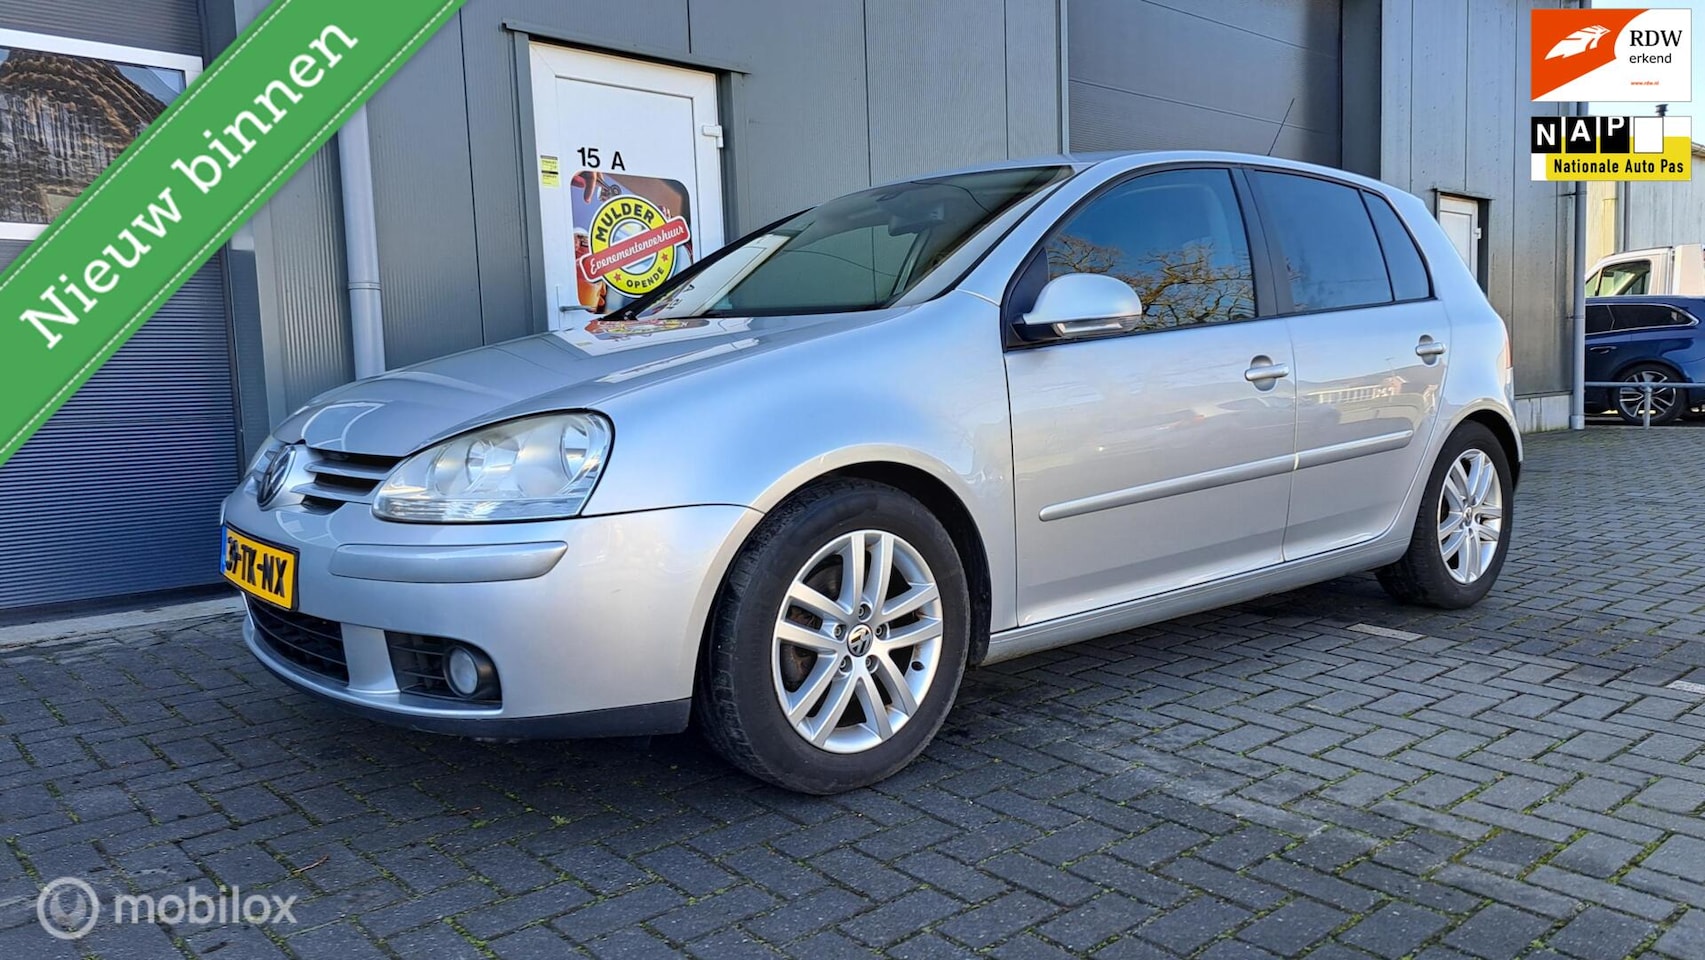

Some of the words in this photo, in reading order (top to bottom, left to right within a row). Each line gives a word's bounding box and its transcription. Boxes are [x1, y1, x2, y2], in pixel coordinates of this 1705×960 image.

[577, 147, 600, 168] 15
[611, 151, 625, 171] A
[595, 202, 655, 243] MULDER
[590, 225, 685, 275] Evenementenverhuur
[626, 266, 665, 289] OPENDE
